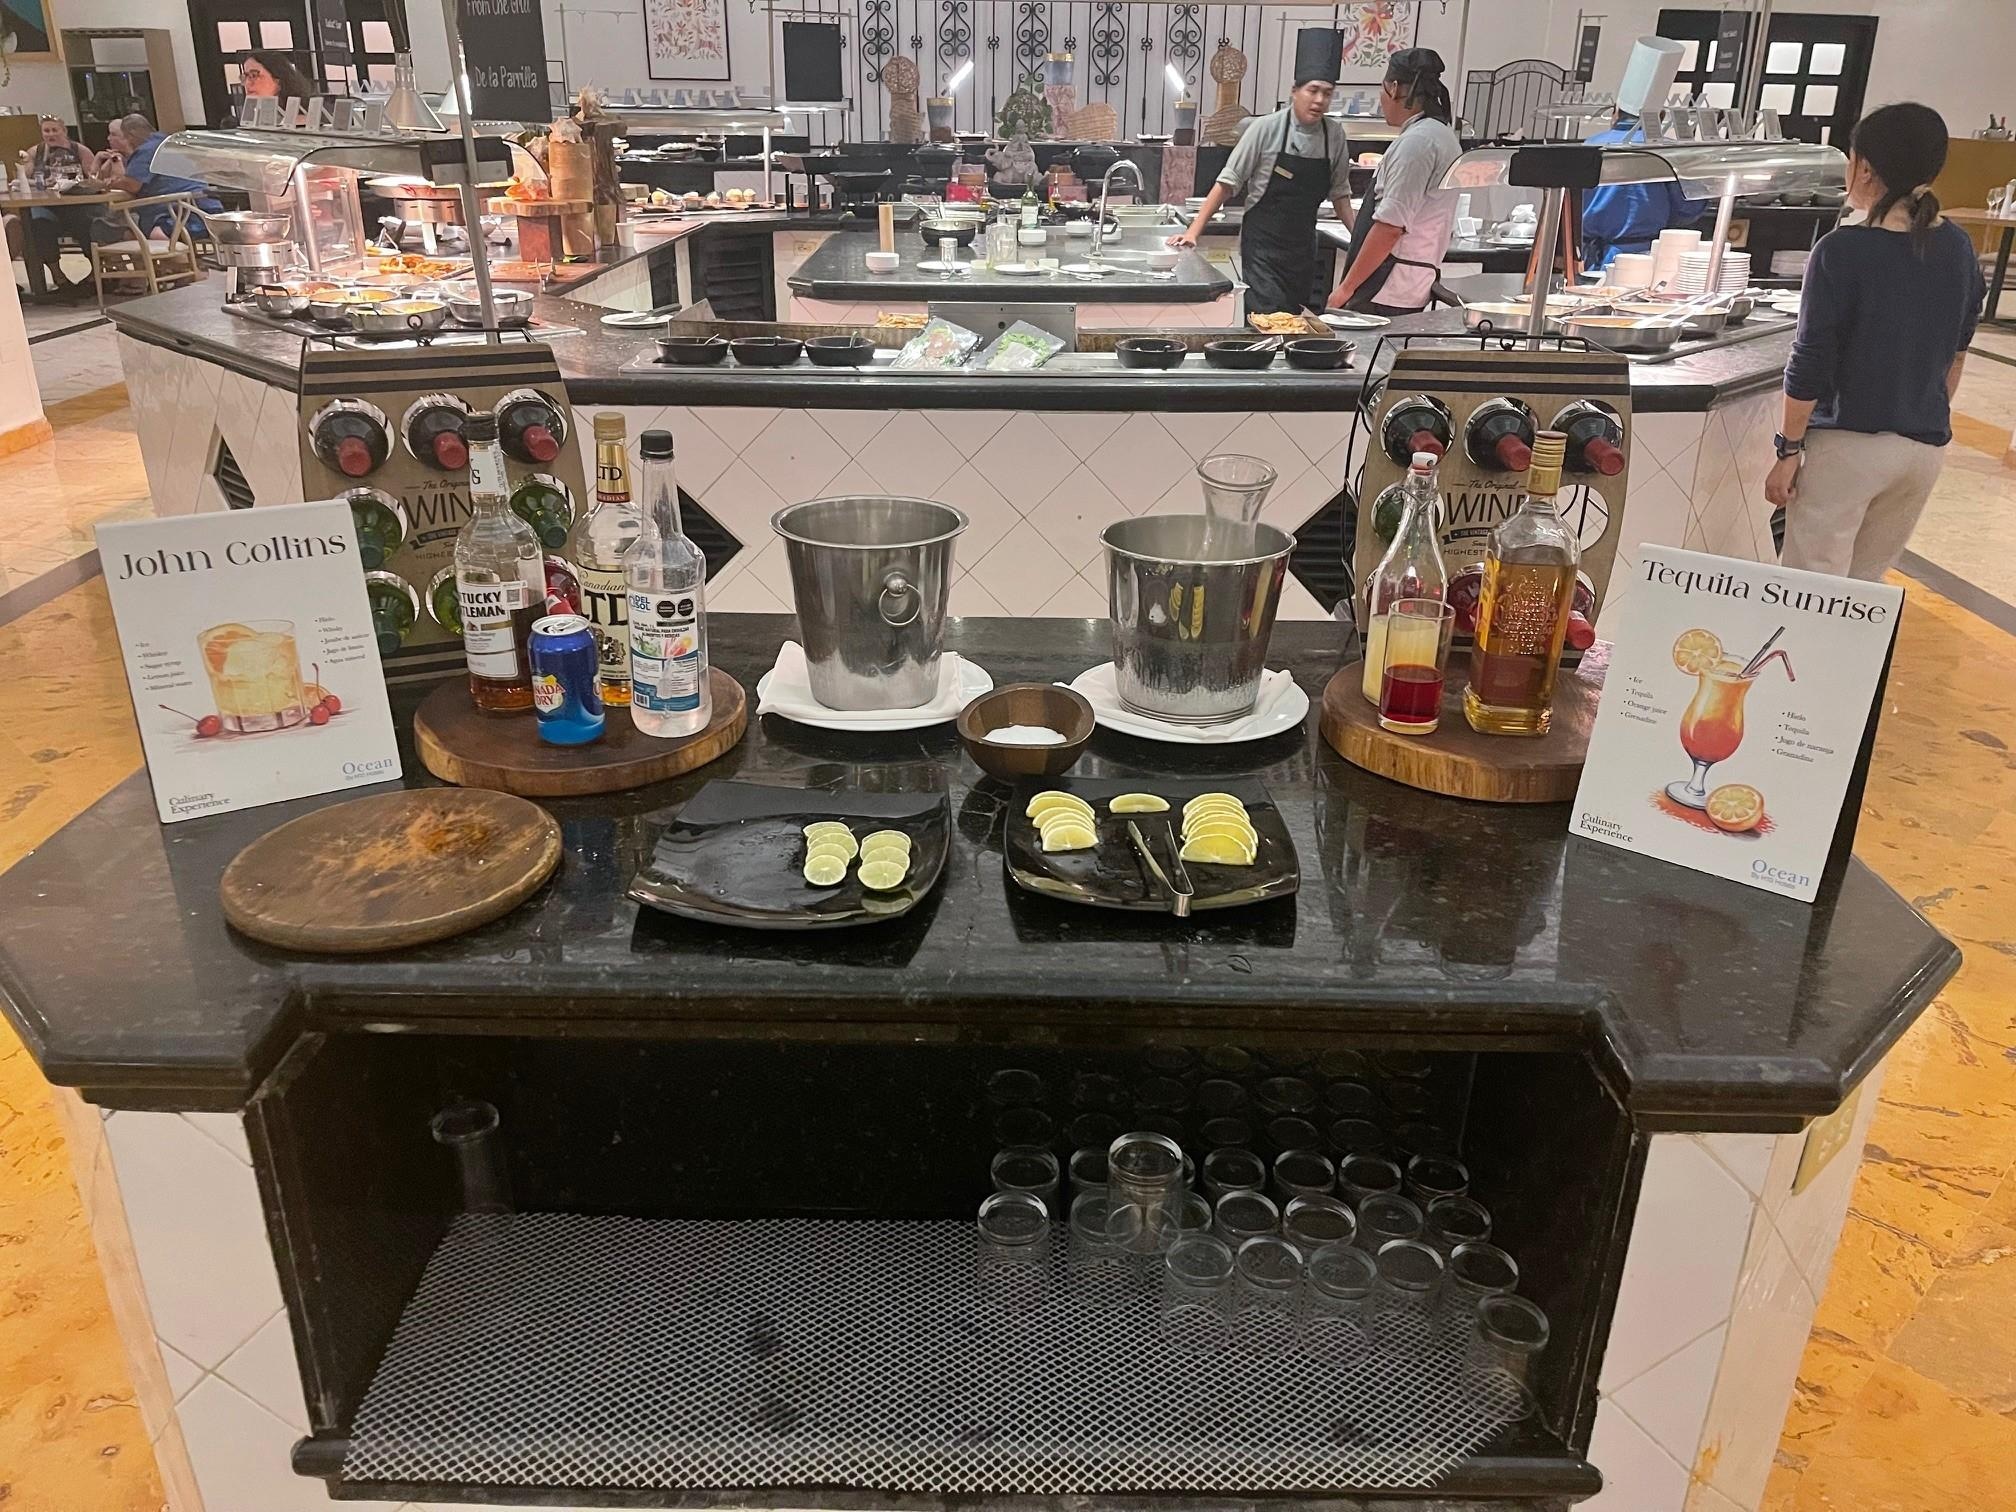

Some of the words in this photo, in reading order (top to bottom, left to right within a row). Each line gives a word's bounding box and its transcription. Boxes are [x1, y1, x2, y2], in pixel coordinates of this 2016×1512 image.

[466, 0, 491, 16] From
[475, 66, 488, 88] De
[489, 66, 499, 88] la
[500, 66, 538, 88] Parrilla
[1468, 480, 1482, 489] The
[1484, 479, 1520, 492] Original
[401, 491, 474, 530] WIN
[119, 549, 213, 580] John
[225, 533, 347, 566] Collins
[1443, 548, 1484, 556] HIGHEST
[580, 570, 625, 591] Canadian
[460, 591, 502, 604] TUCKY
[635, 595, 651, 604] DEL
[1641, 559, 1751, 601] Tequila
[1759, 582, 1888, 625] Sunrise
[634, 603, 651, 611] SOL
[534, 682, 567, 696] NADA
[535, 694, 554, 706] DRY
[342, 758, 393, 775] Ocean
[169, 793, 214, 806] Culinary
[170, 798, 232, 815] Experience
[1581, 812, 1624, 832] Culinary
[1580, 820, 1634, 843] Experience
[1752, 859, 1809, 887] Ocean
